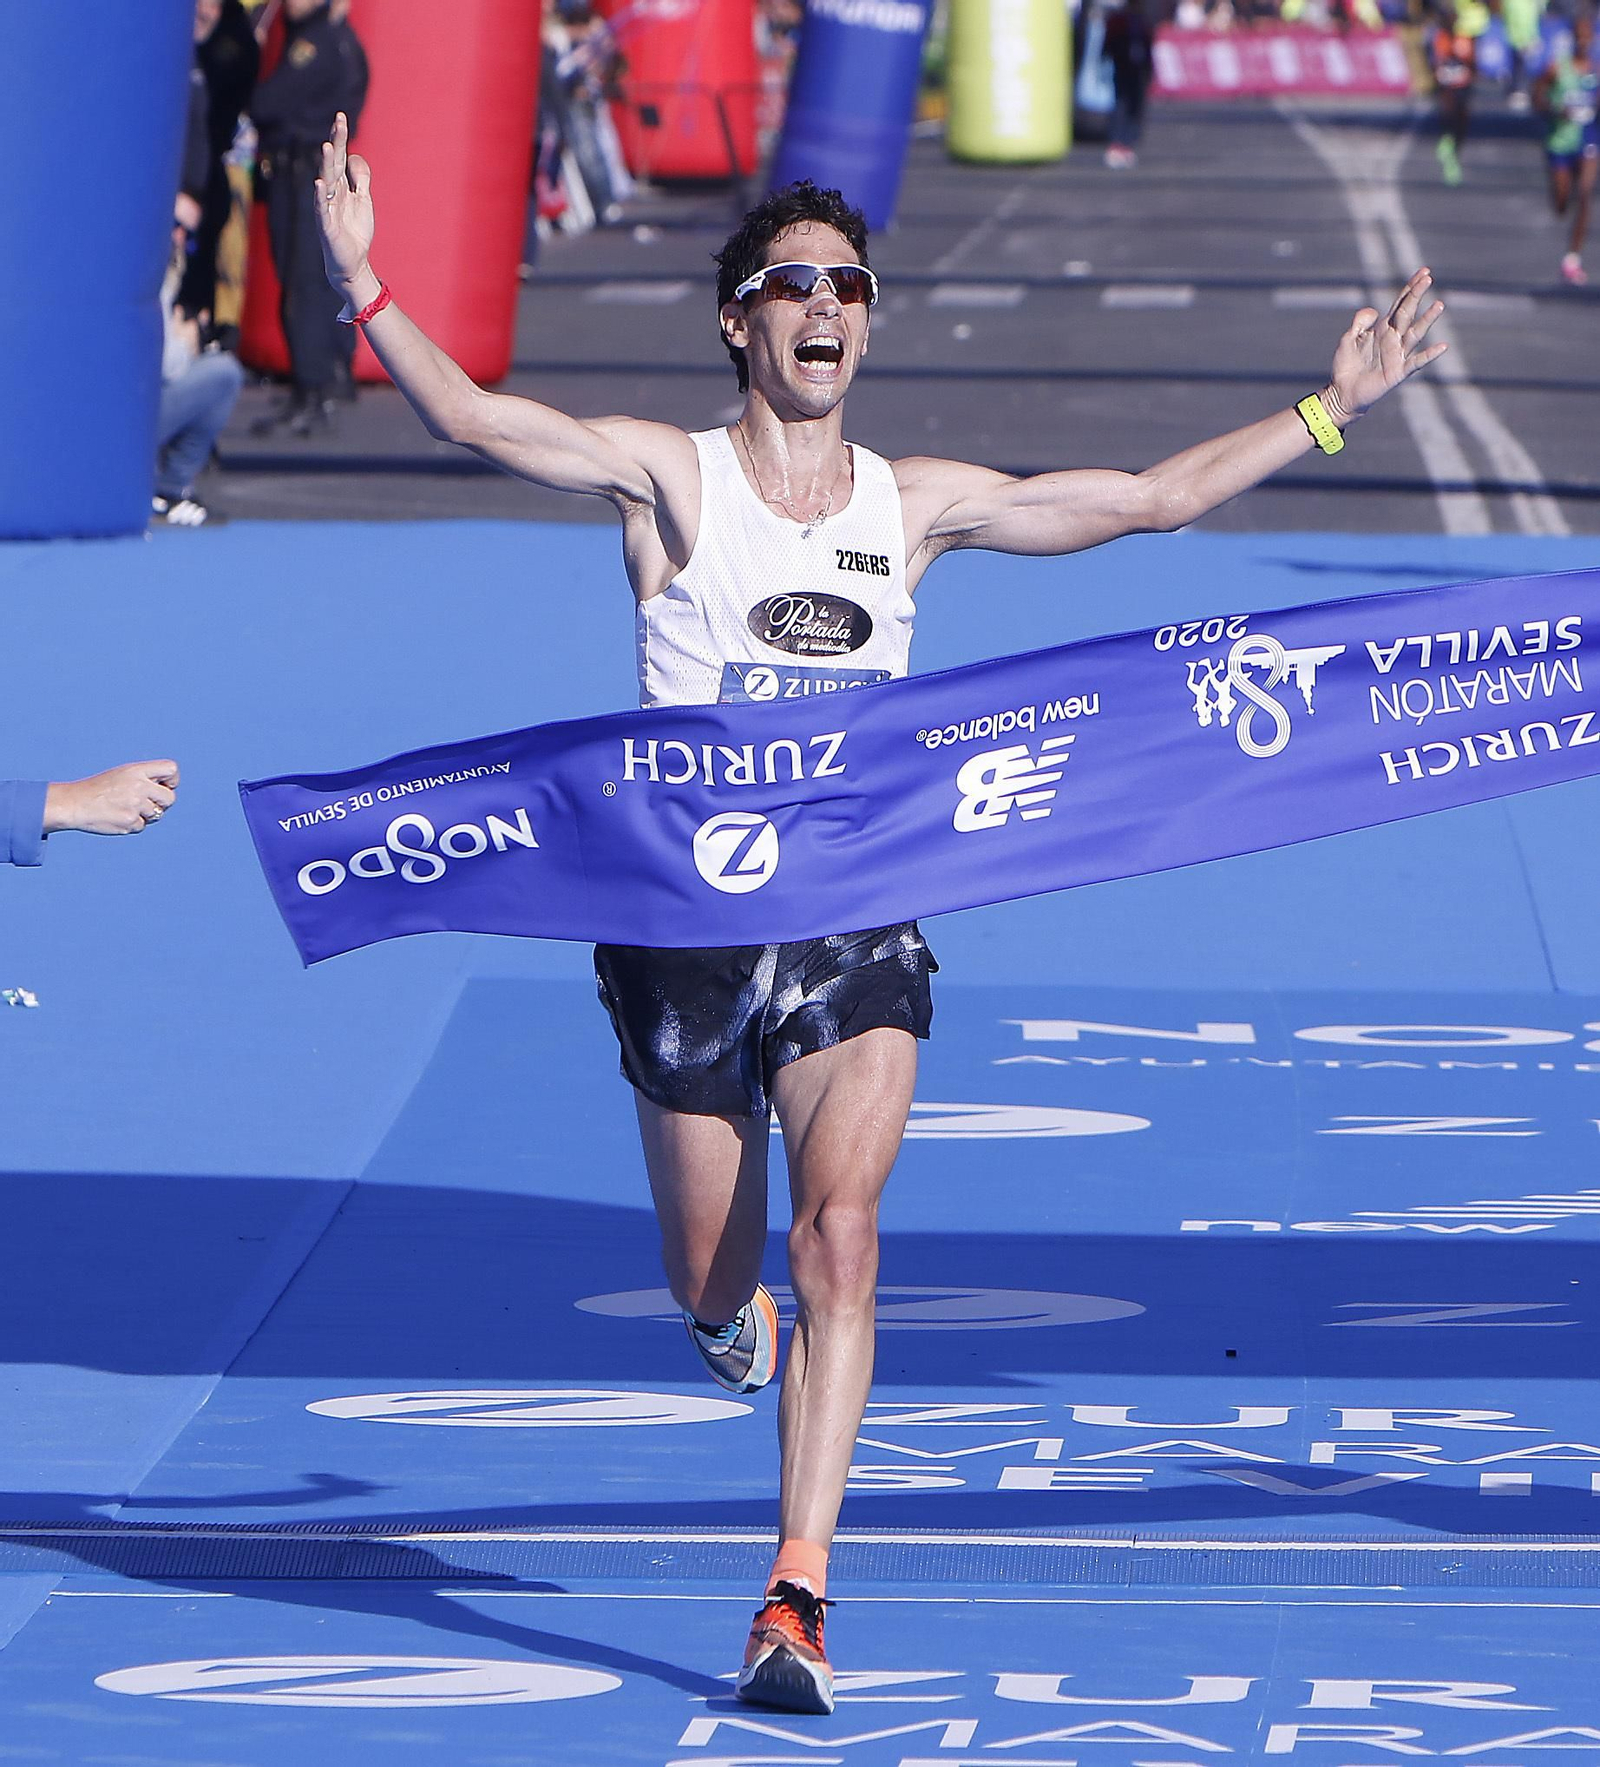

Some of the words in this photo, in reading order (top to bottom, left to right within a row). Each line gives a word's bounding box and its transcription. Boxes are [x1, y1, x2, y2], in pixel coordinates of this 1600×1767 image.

[836, 549, 890, 577] 226ERS
[764, 594, 852, 641] Portada
[1154, 614, 1251, 652] 2020
[797, 638, 808, 651] de
[1364, 615, 1582, 674] SEVILLA
[1041, 692, 1100, 725] new
[1369, 656, 1584, 727] MARATÓN
[622, 730, 847, 787] ZURICH
[1379, 711, 1600, 785] ZURICH
[377, 761, 511, 801] AYUNTAMIENTO
[278, 801, 348, 833] SEVILLA
[347, 792, 374, 812] DE
[844, 1464, 1600, 1498] SEVI
